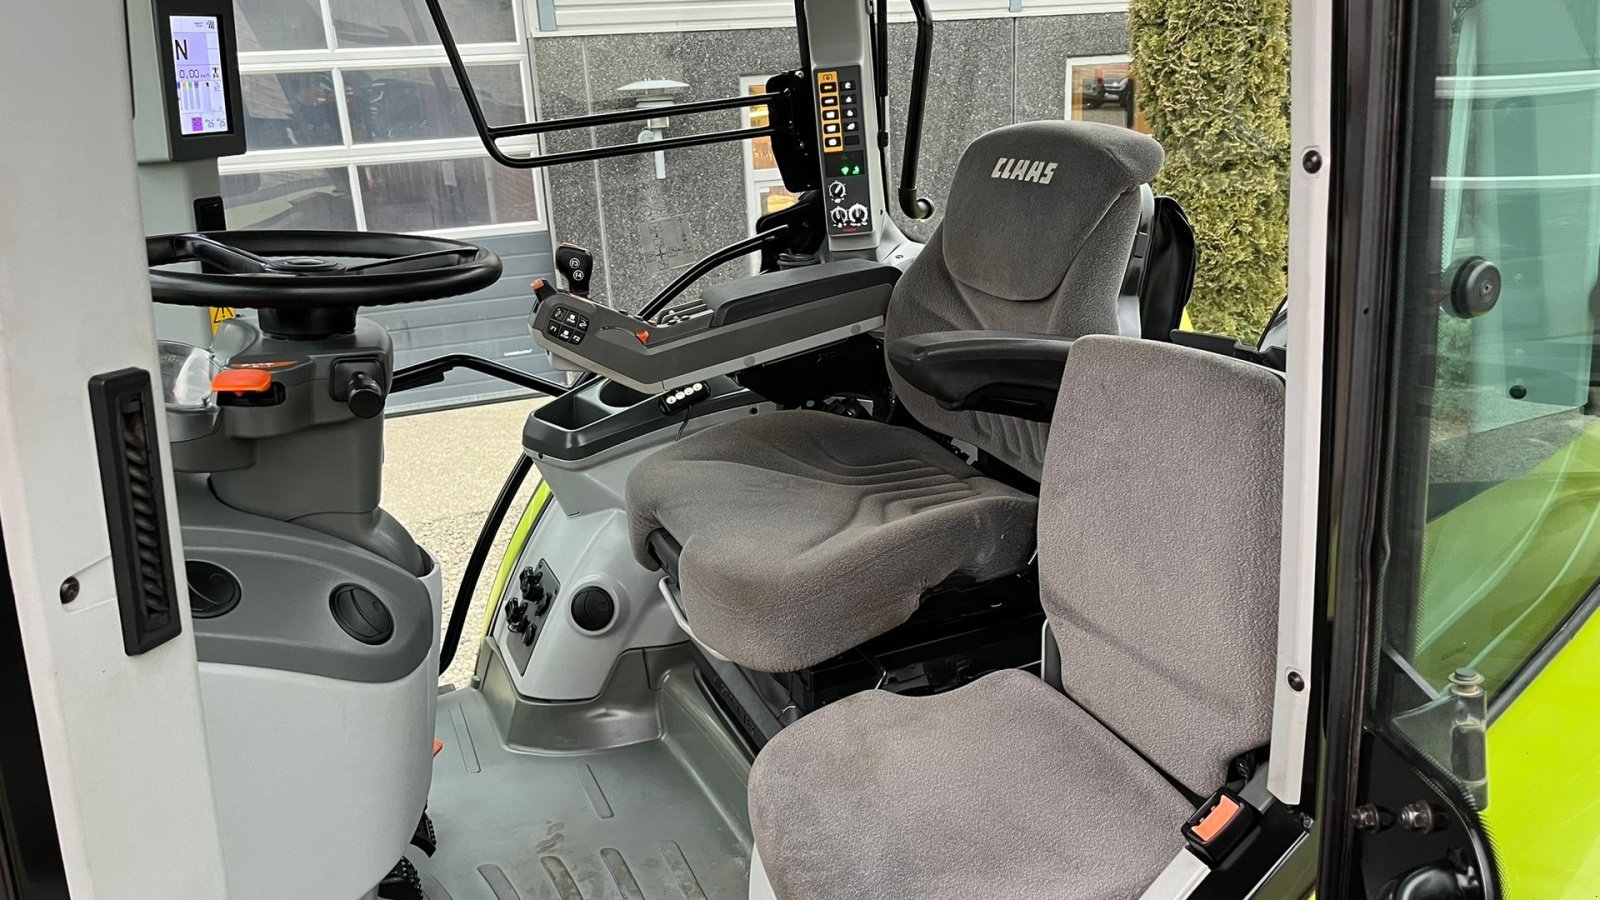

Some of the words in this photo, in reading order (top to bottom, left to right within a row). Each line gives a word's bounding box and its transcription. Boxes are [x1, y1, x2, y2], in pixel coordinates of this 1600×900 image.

[174, 39, 188, 60] N
[179, 69, 199, 79] 0.00
[991, 157, 1058, 185] CLAAS
